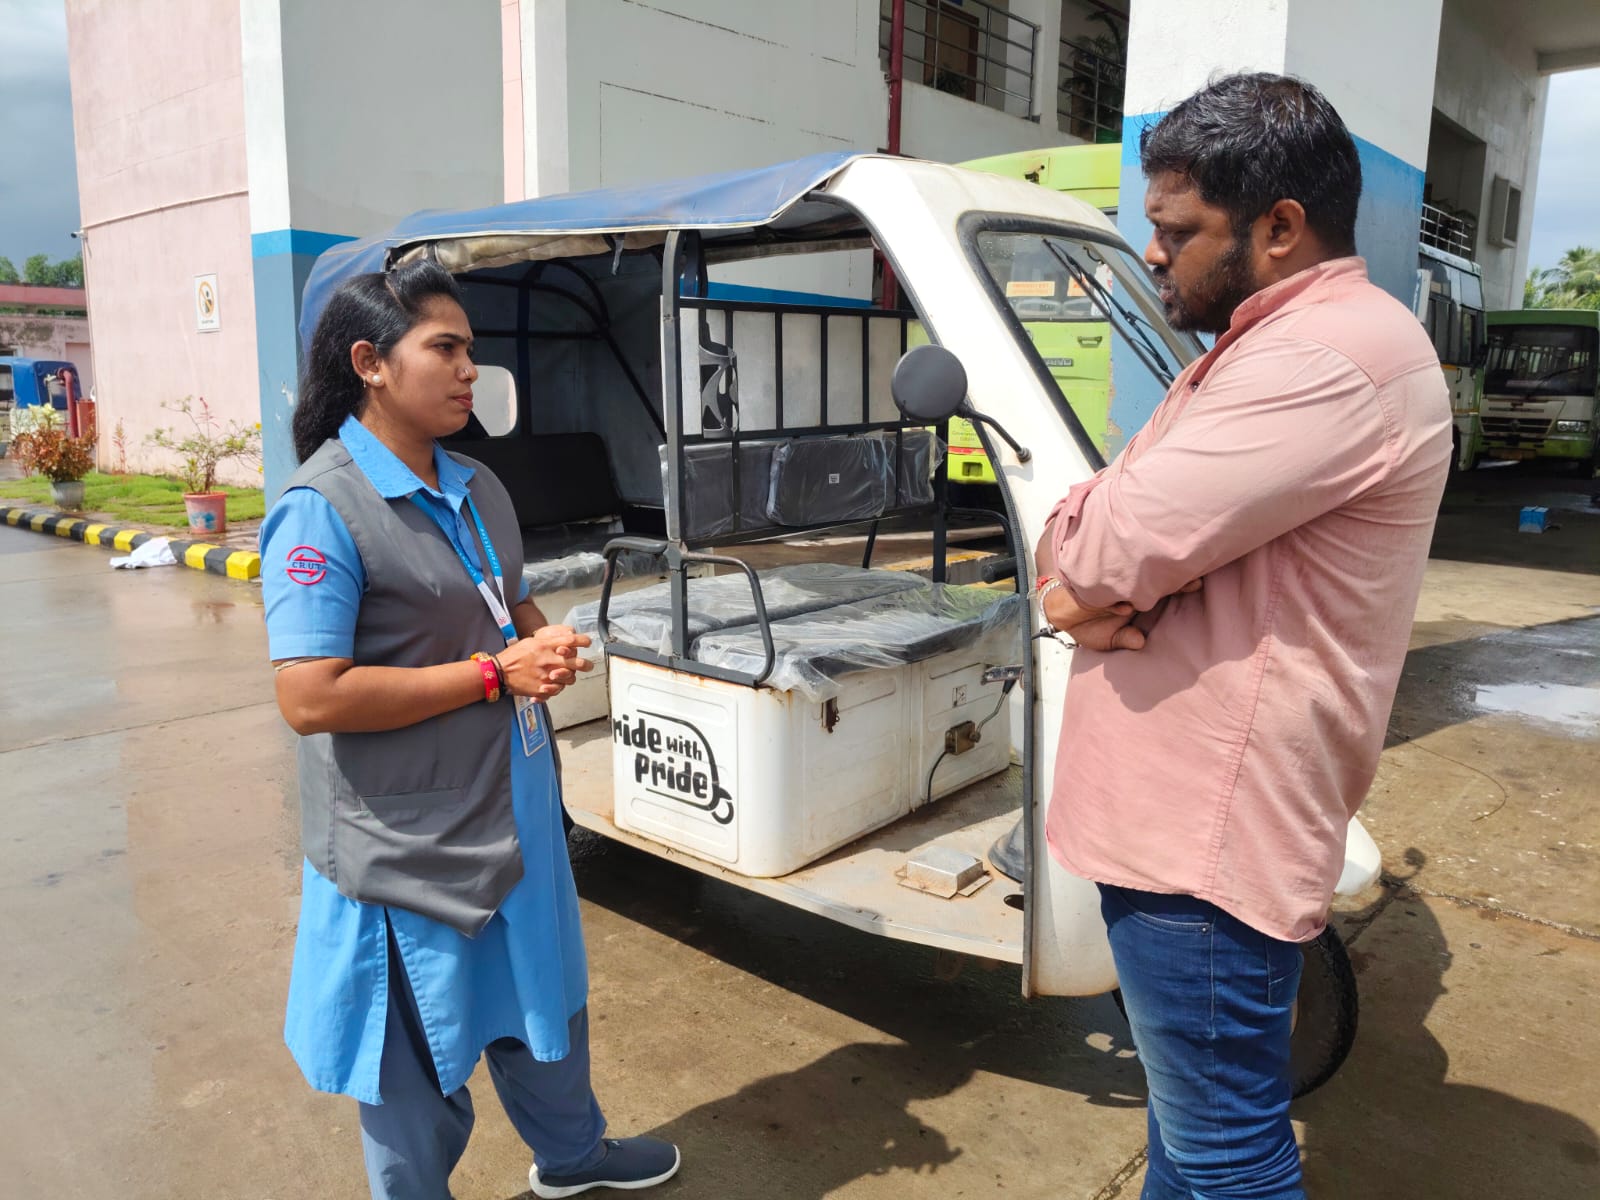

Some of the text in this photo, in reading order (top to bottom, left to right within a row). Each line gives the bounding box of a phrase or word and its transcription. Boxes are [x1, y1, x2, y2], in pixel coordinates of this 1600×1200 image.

[291, 561, 322, 571] CRUT
[613, 714, 702, 761] ride with
